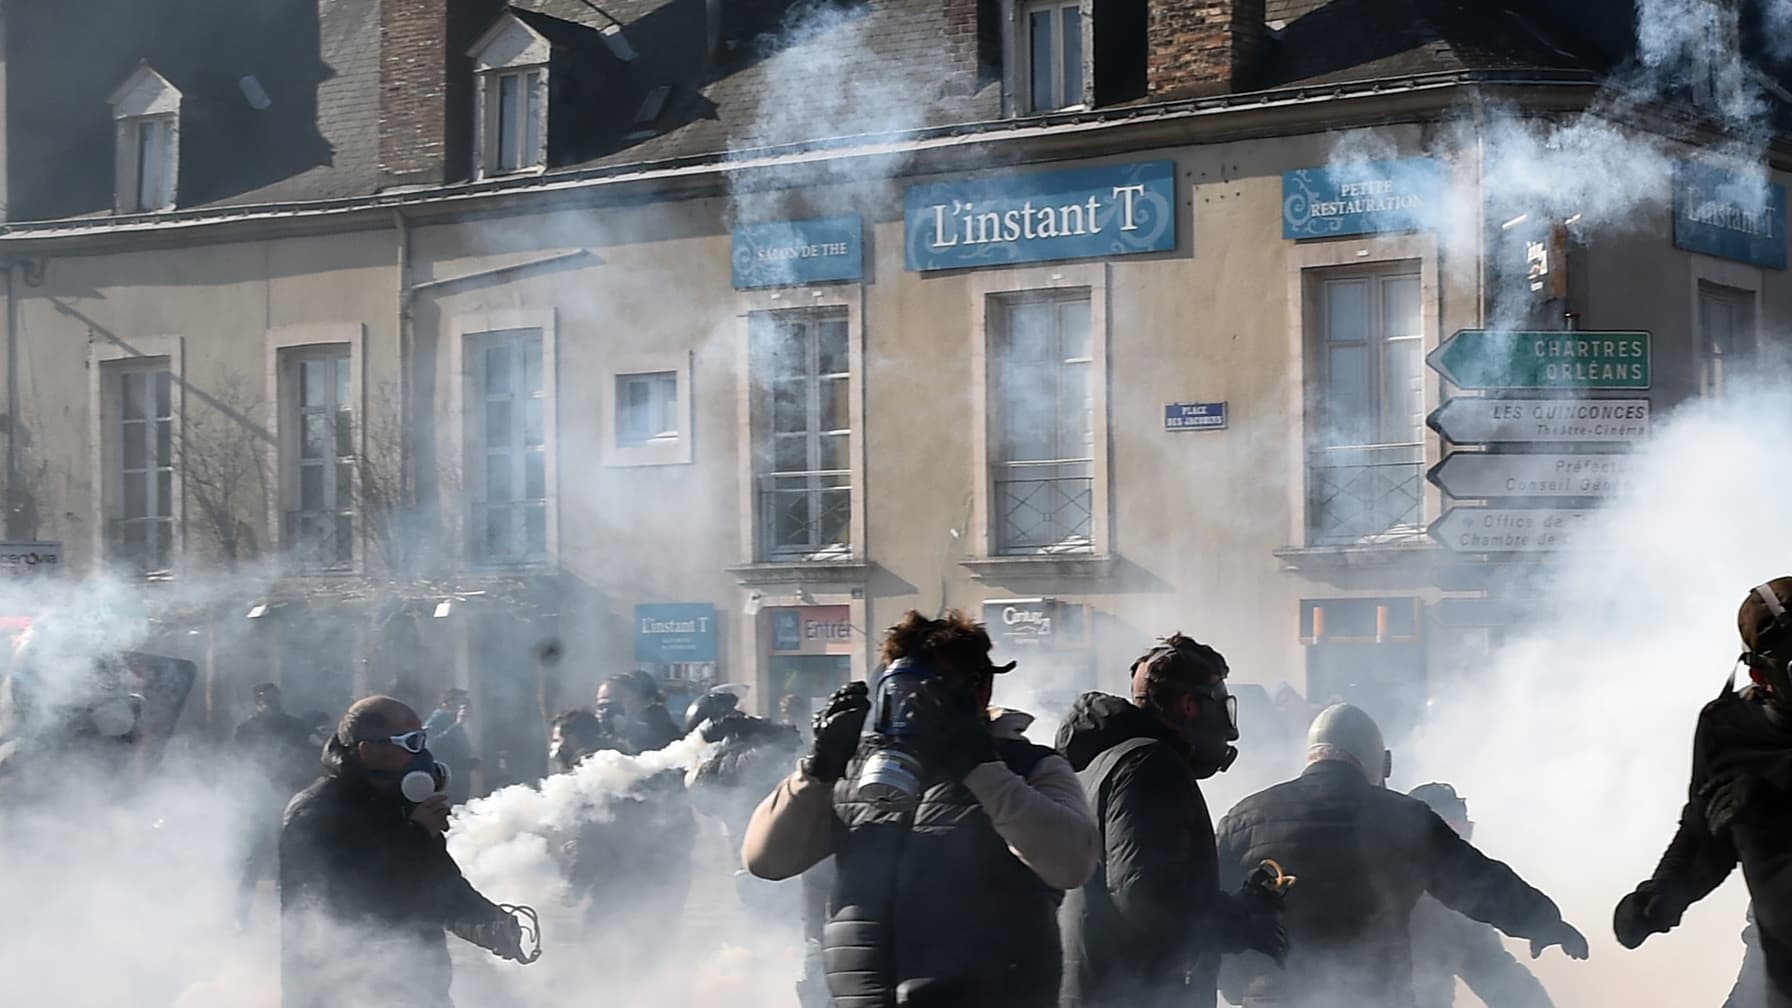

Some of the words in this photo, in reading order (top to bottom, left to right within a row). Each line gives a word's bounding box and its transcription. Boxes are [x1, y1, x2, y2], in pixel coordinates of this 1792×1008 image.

[1341, 180, 1393, 197] PETITE
[932, 195, 1103, 248] L'instant
[1112, 184, 1144, 231] T
[801, 244, 819, 258] DE
[822, 242, 849, 256] THE
[1535, 341, 1643, 358] CHARTRES
[1546, 361, 1643, 380] ORLÉANS
[1493, 406, 1522, 419] LES
[1533, 406, 1645, 419] QUINCONCES
[1555, 459, 1642, 473] Préfectu
[1506, 477, 1571, 491] Conseil
[1484, 514, 1534, 528] Office
[1543, 514, 1562, 528] de
[1459, 533, 1529, 546] Chambre
[698, 616, 708, 633] T
[806, 618, 851, 639] Entré
